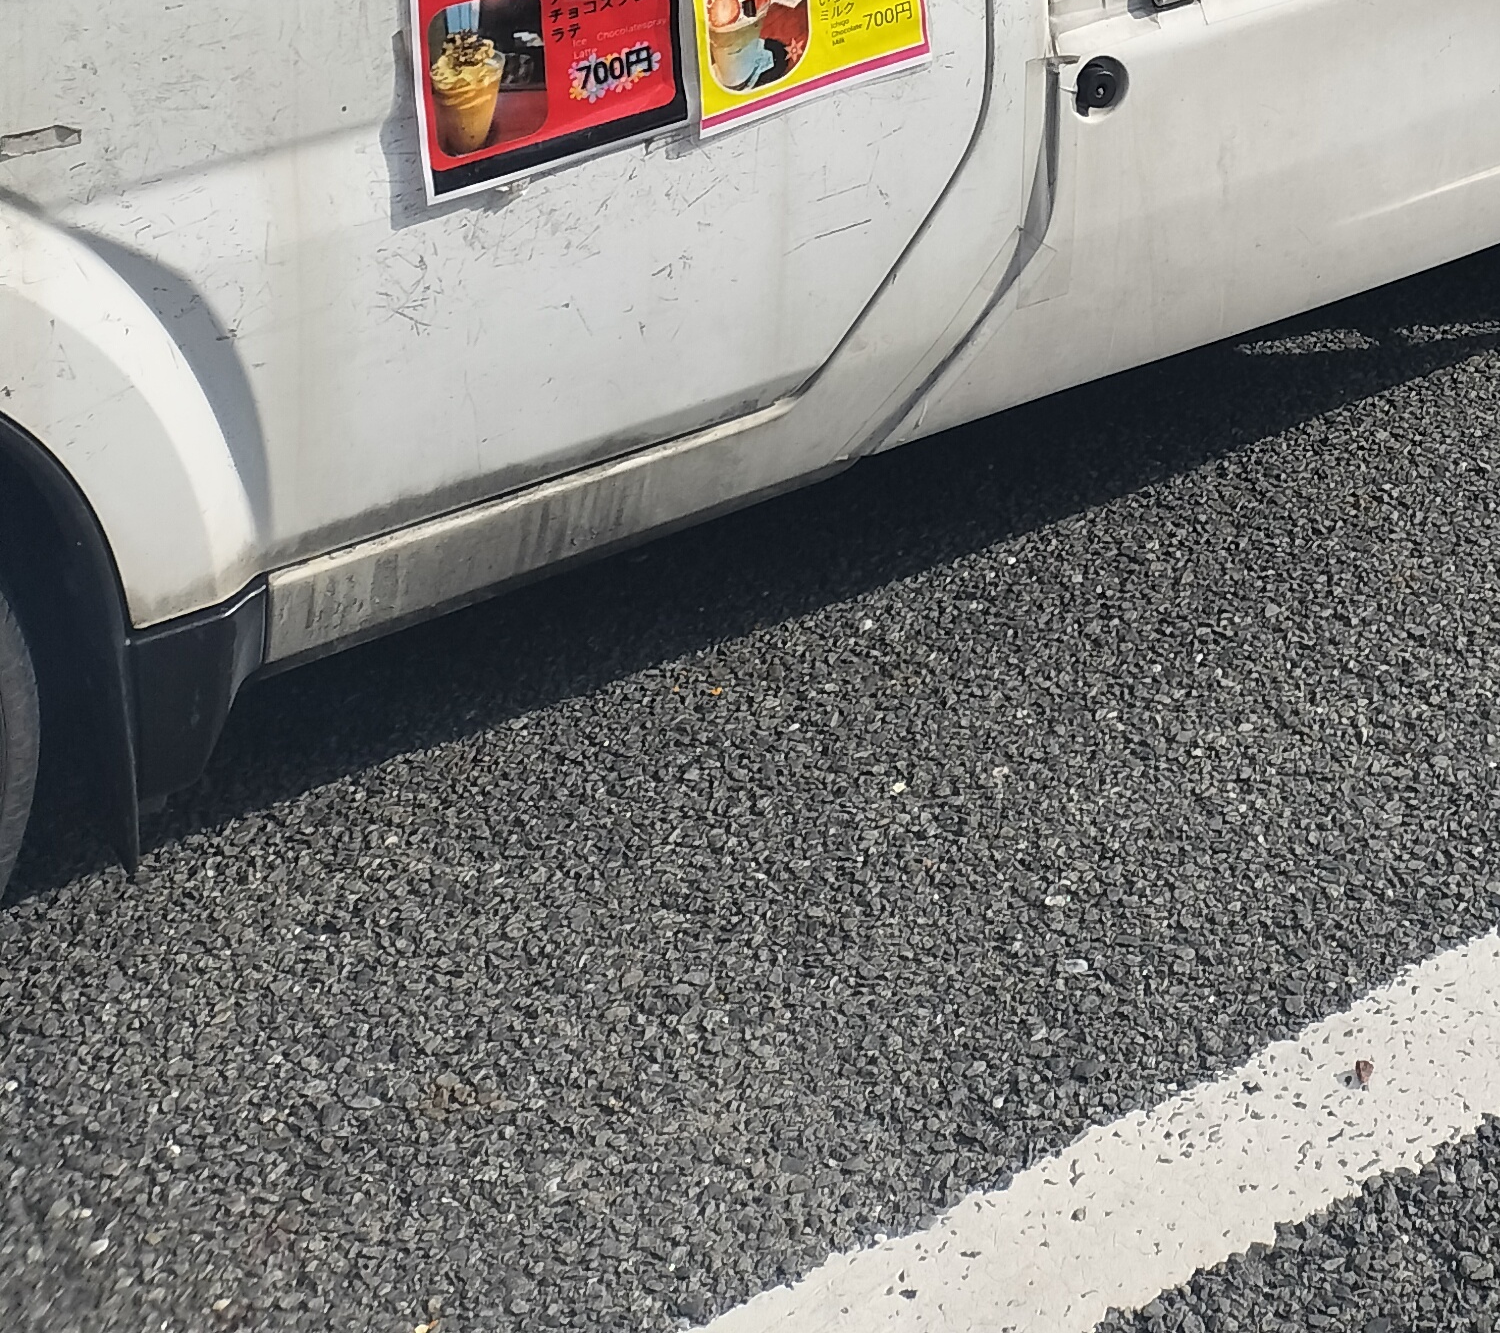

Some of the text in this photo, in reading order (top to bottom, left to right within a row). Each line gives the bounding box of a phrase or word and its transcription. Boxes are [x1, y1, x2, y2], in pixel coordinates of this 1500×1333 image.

[820, 1, 855, 21] ミルク
[862, 0, 912, 31] 700円
[552, 23, 581, 42] ラテ
[576, 45, 653, 90] 700円
